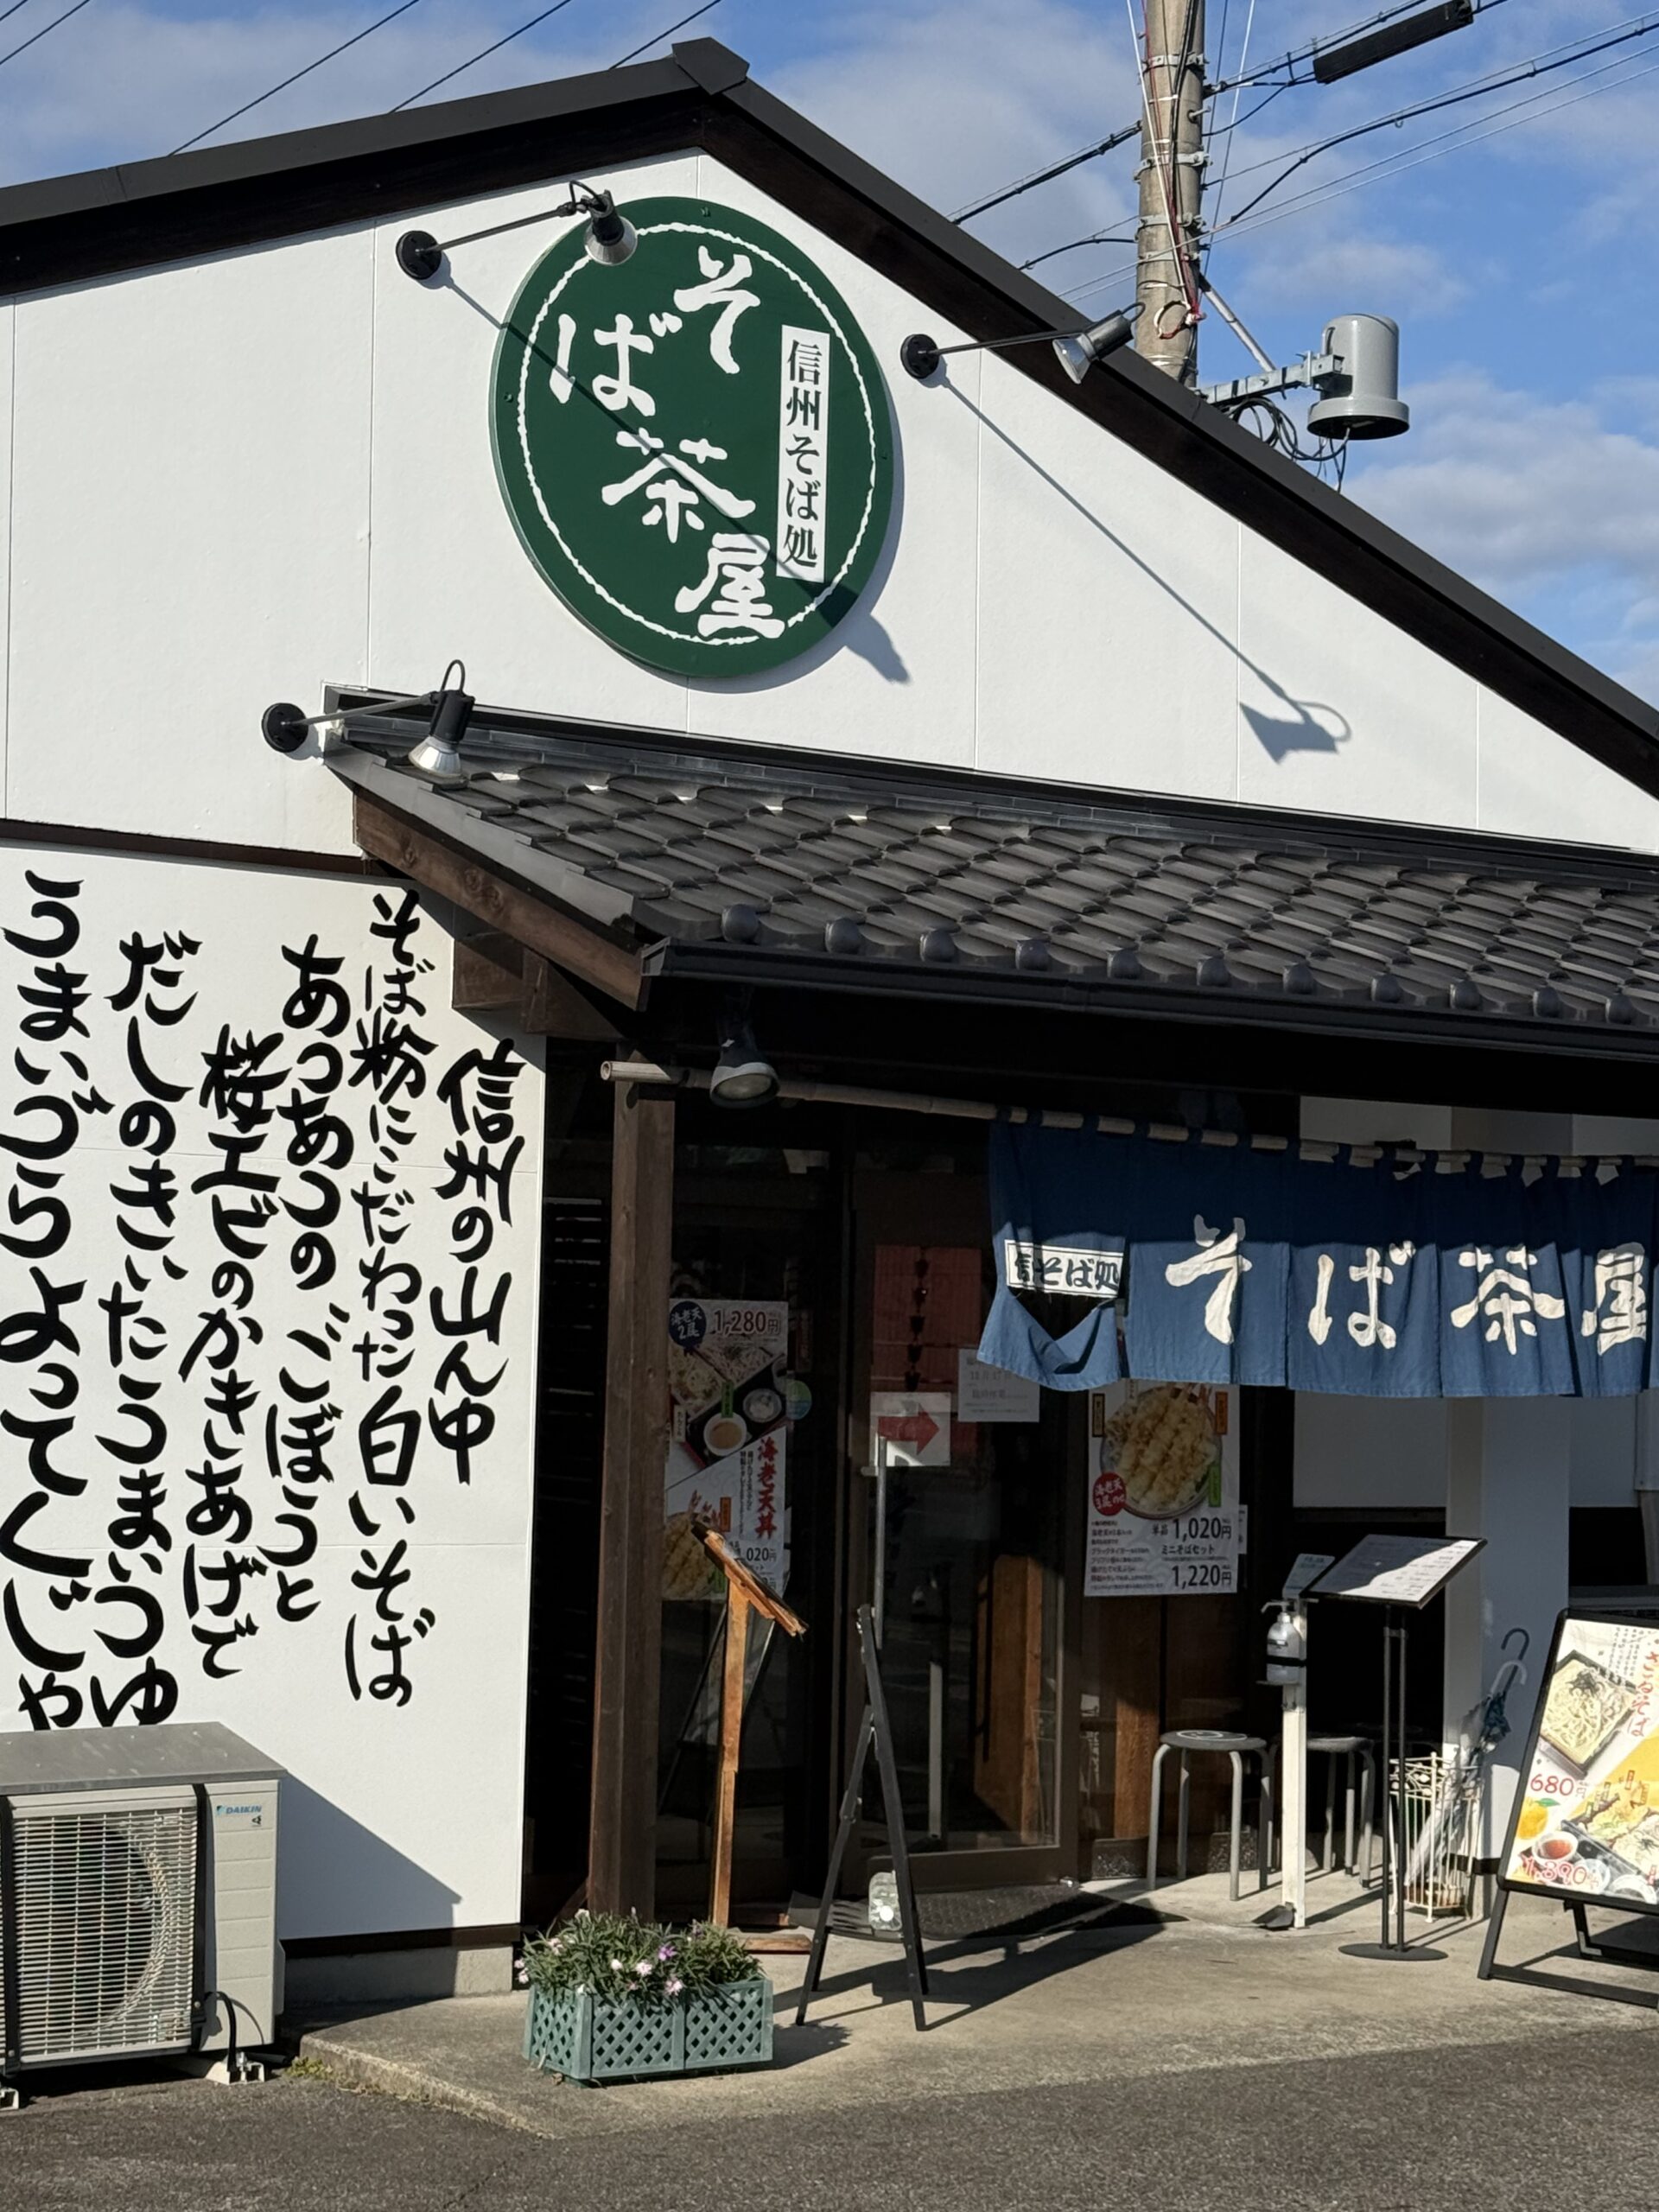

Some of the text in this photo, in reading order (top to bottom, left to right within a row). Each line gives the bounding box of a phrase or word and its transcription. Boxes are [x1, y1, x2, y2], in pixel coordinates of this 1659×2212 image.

[782, 340, 823, 569] 信州そば処
[91, 931, 203, 1727] だしのきいたうまいつゆ
[178, 1023, 293, 1679] 桜エビのかきあげで
[257, 934, 355, 1623] あつあつのごぼうと
[346, 889, 439, 1707] そば粉にこだわった白いそば
[429, 1038, 528, 1485] 信州の山ん中
[714, 1309, 780, 1336] 1,280円
[1165, 1214, 1647, 1356] そば茶屋
[1161, 1544, 1216, 1555] ミニそばセット
[1171, 1565, 1232, 1590] 1,220円
[1172, 1517, 1232, 1542] 1,020円
[226, 1805, 263, 1815] DAIKIN
